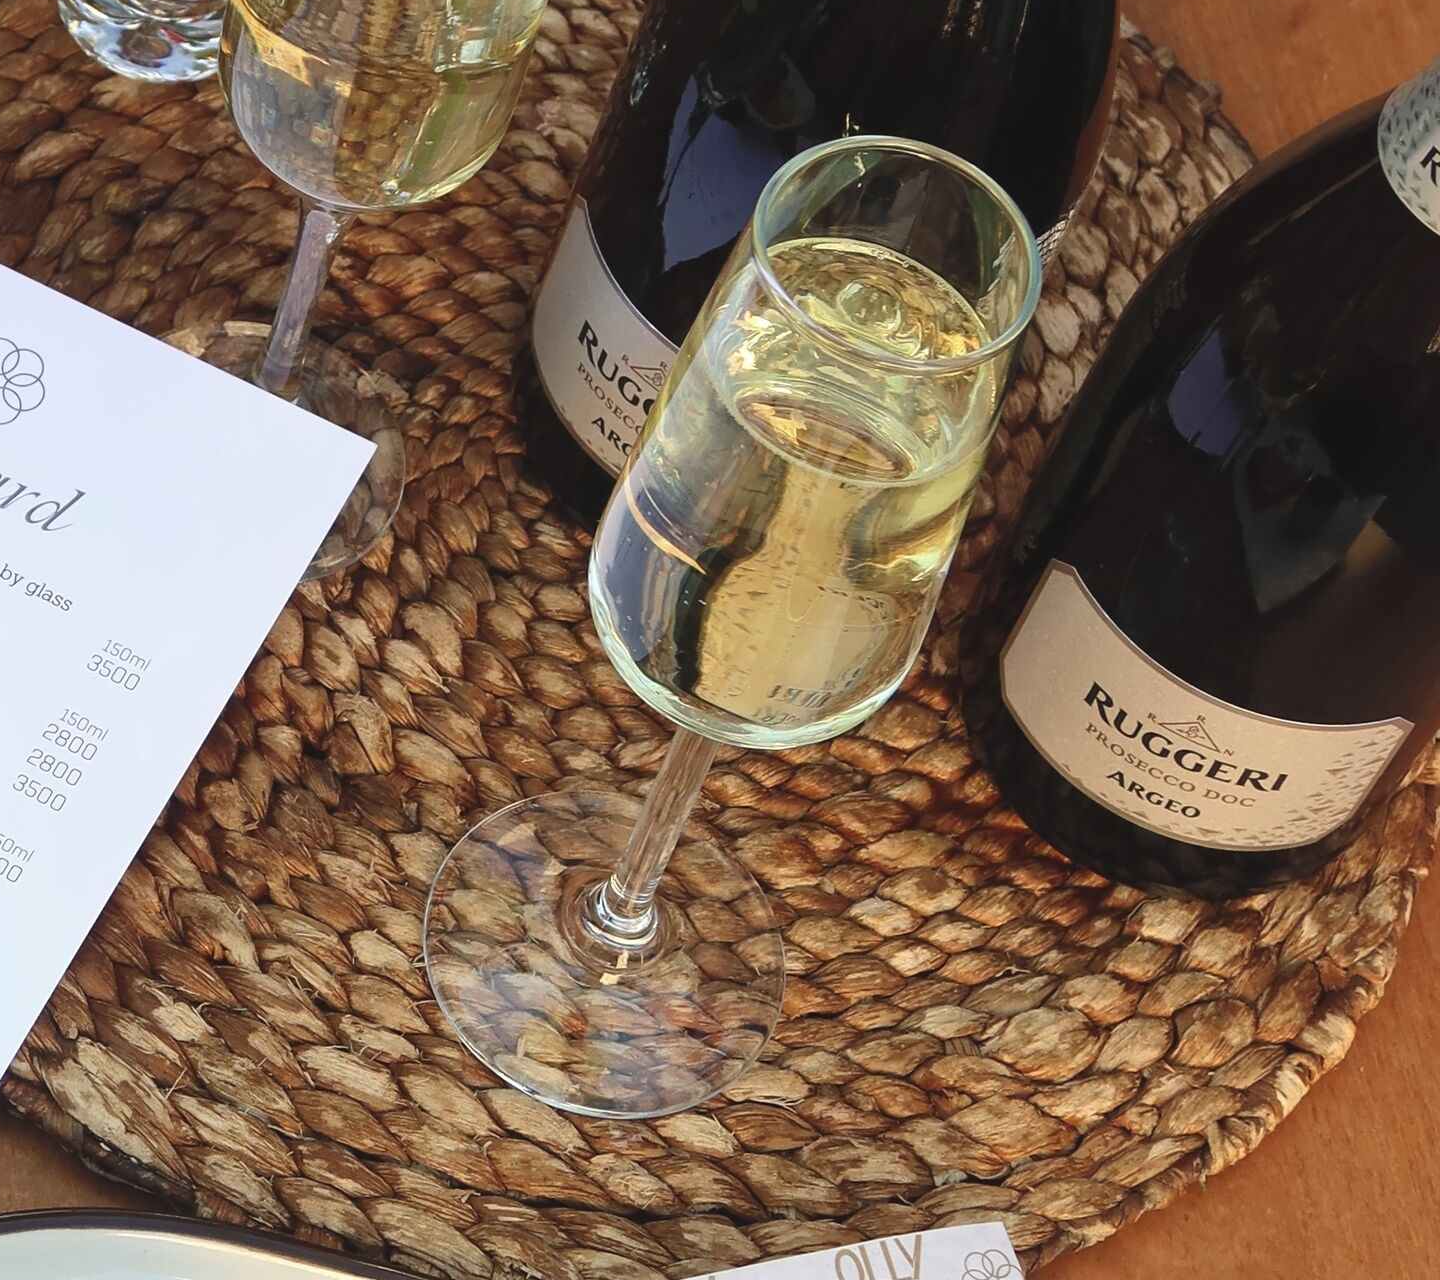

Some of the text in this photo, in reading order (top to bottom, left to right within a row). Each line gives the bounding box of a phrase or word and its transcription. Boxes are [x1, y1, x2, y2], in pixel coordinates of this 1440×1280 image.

[23, 581, 73, 612] glass
[86, 654, 141, 691] 3500
[101, 639, 152, 672] 150ml
[41, 722, 98, 761] 2800
[58, 708, 110, 742] 150ml
[1084, 681, 1289, 793] RUGGERI
[26, 747, 83, 787] 2800
[1085, 722, 1258, 809] PROSECCO DOC
[12, 773, 67, 812] 3500
[1106, 770, 1201, 819] ARGEO
